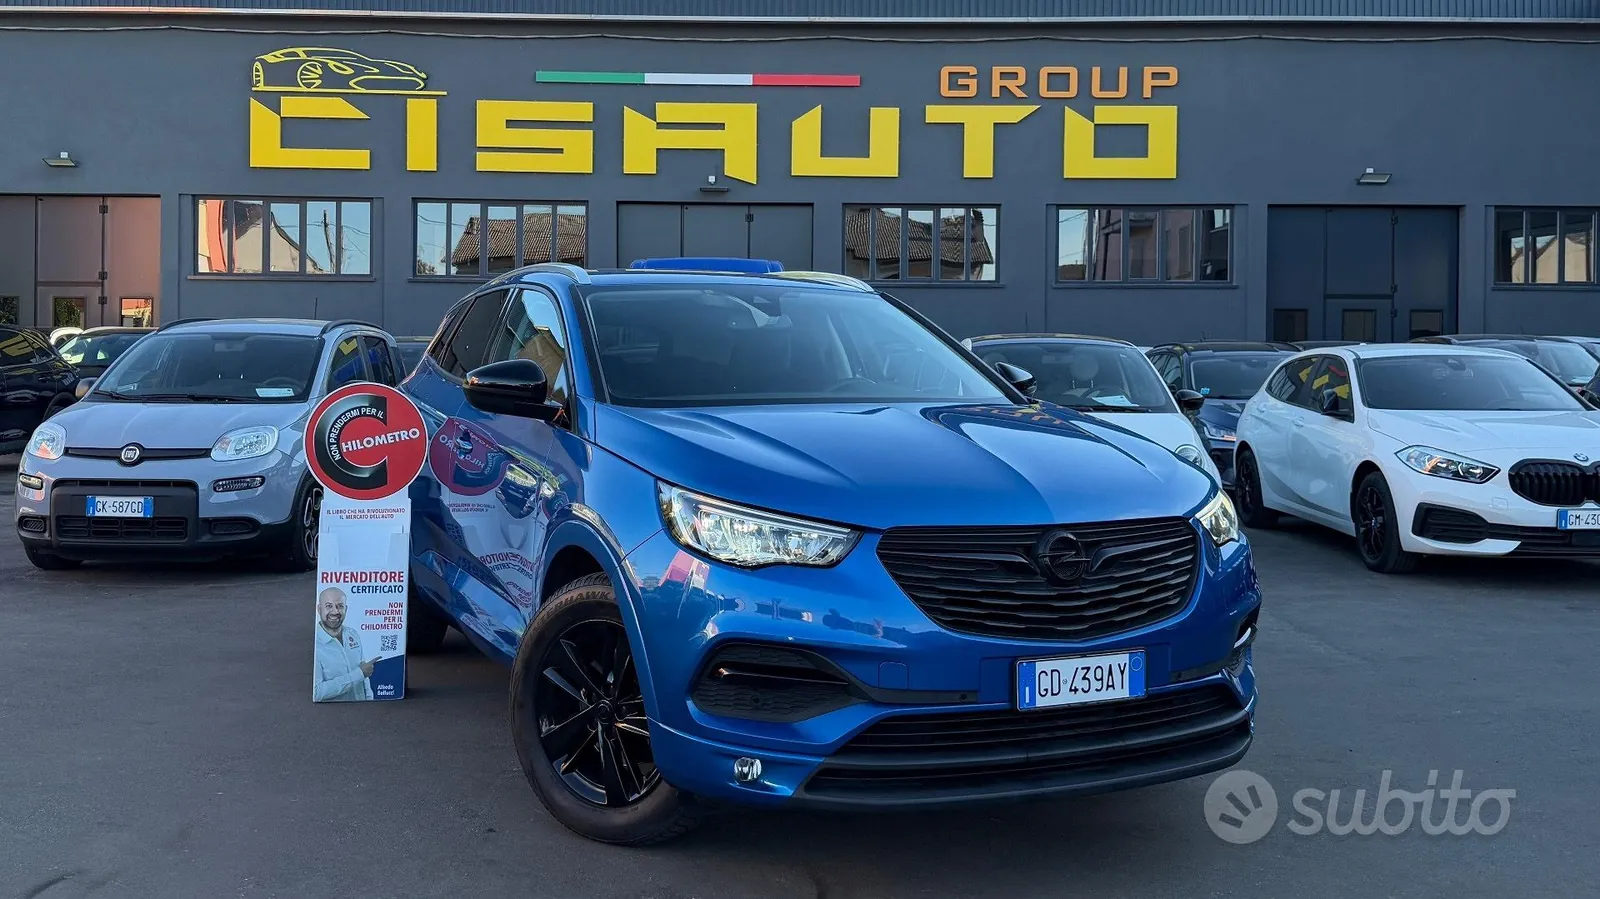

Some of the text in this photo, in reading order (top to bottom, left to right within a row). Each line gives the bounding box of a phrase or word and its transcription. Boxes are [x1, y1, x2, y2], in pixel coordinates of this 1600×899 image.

[940, 65, 1178, 98] GROUP
[250, 97, 1179, 185] CISAUTO
[330, 407, 384, 461] NON PRENDERMI PER IL
[321, 571, 404, 583] RIVENDITORE
[351, 585, 404, 594] CERTIFICATO
